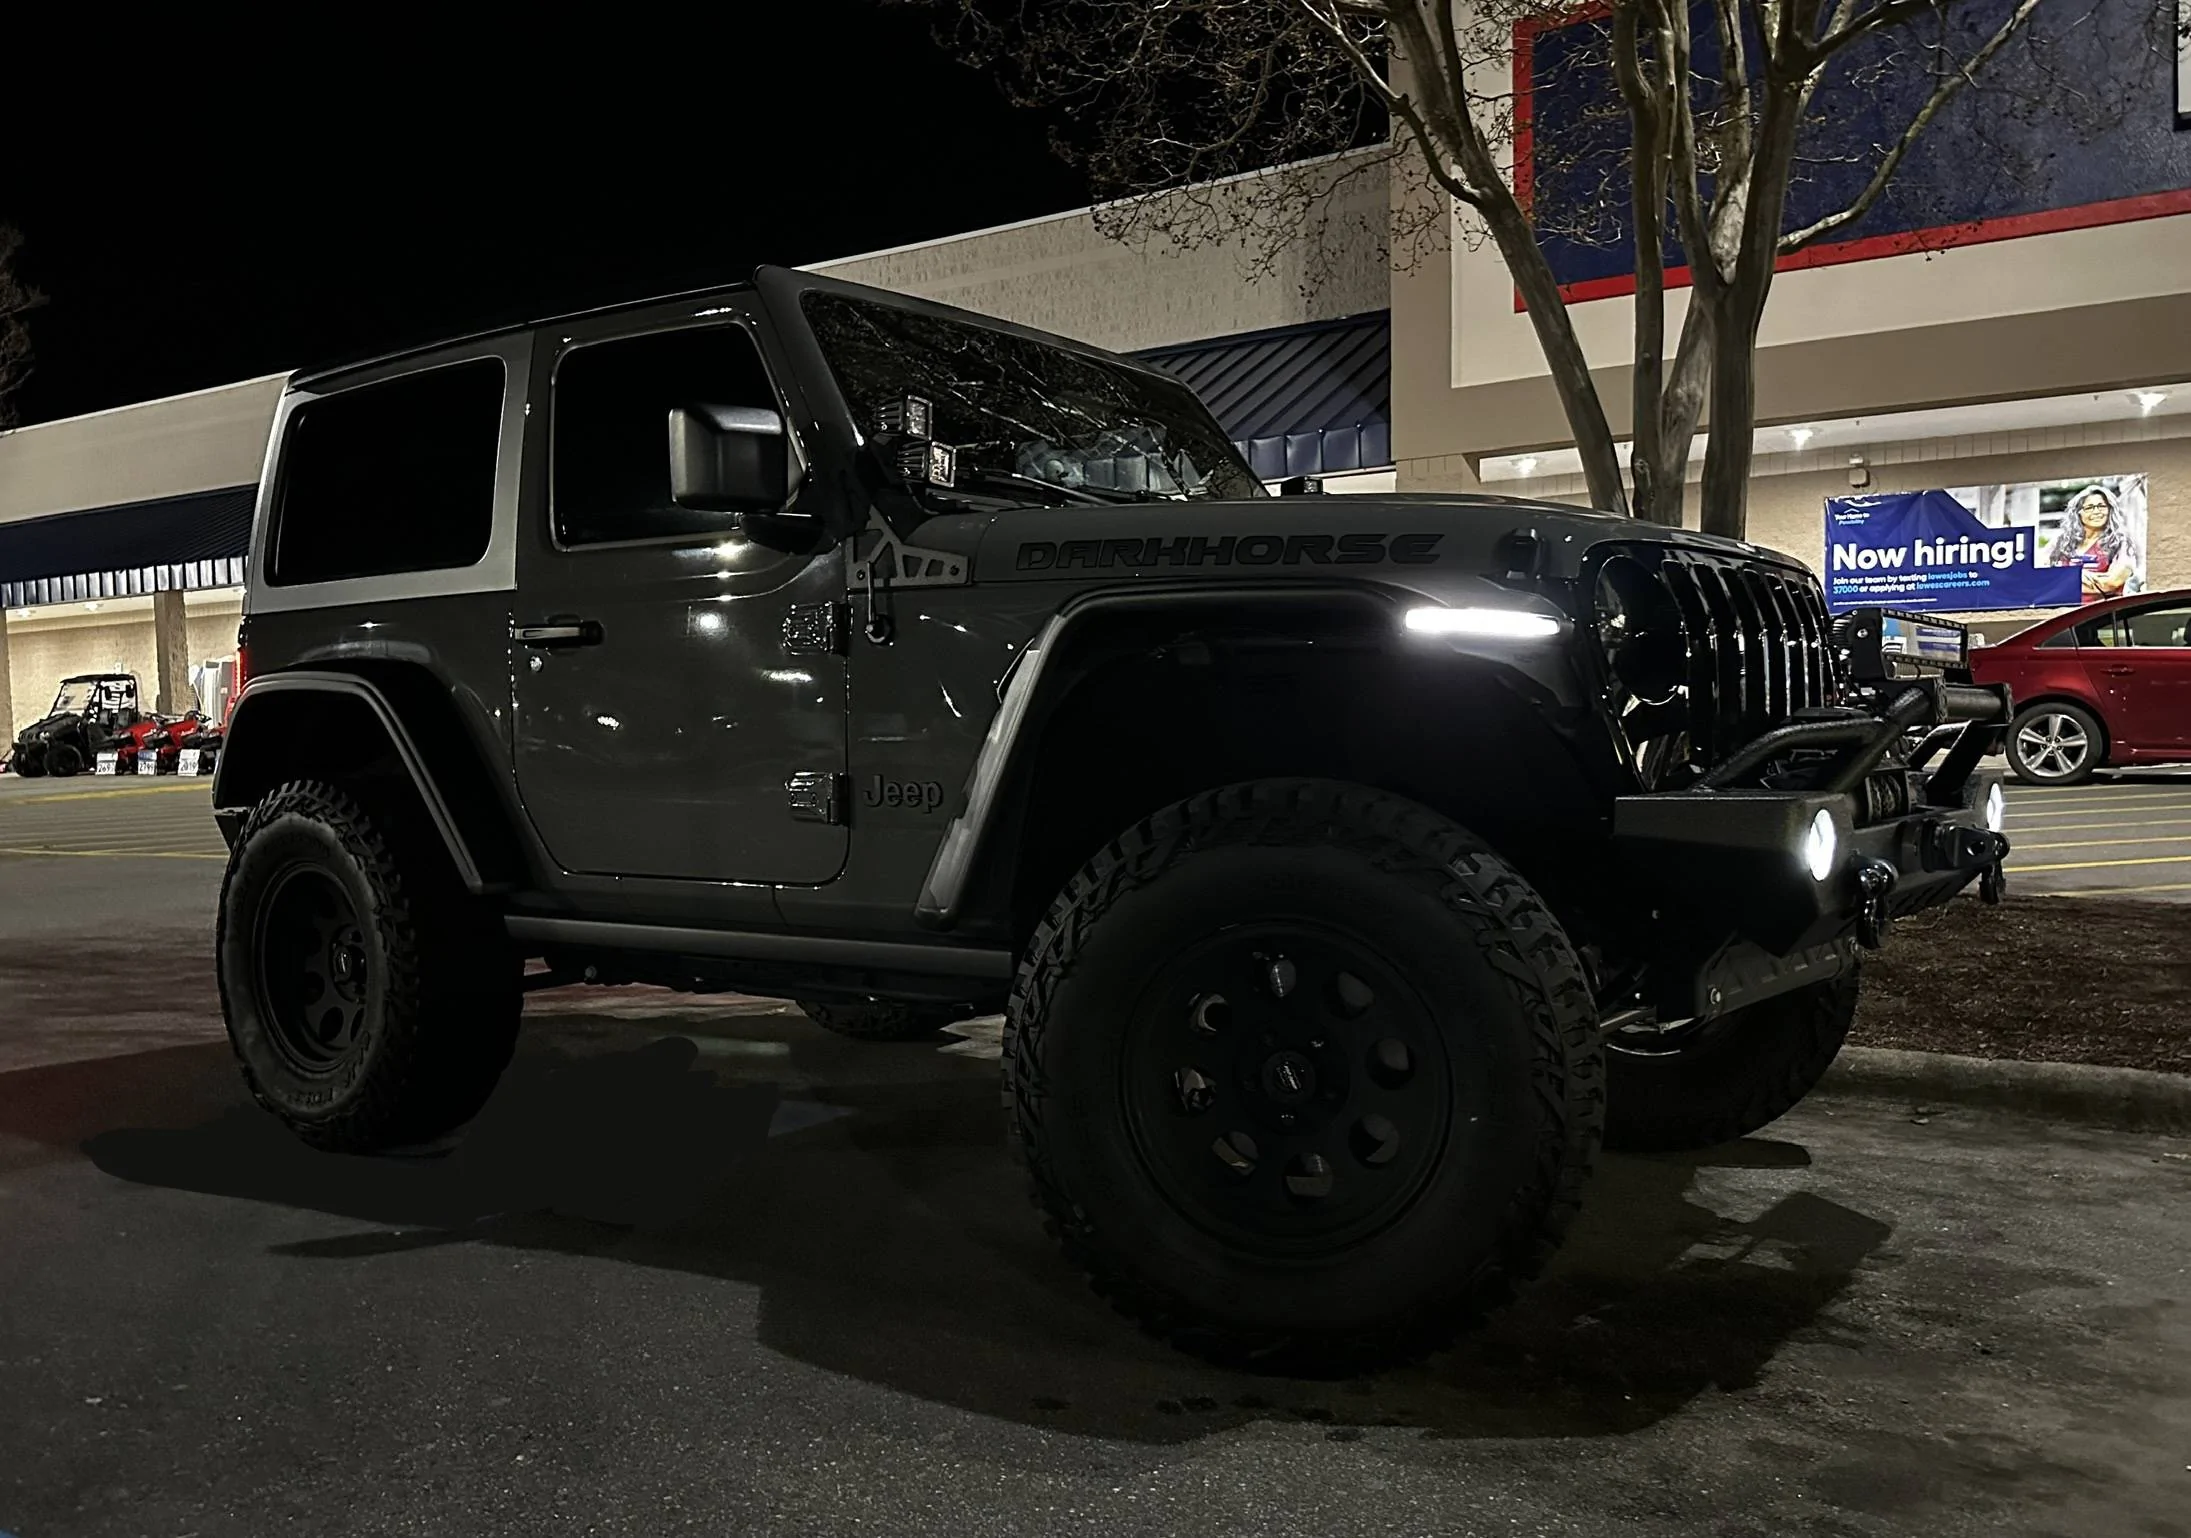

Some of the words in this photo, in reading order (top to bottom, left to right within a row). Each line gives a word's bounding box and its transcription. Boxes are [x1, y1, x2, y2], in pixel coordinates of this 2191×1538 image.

[1015, 533, 1445, 571] DARKHORSE
[1833, 544, 1907, 570] Now
[1914, 533, 2025, 569] hiring!
[1833, 576, 1849, 586] Join
[1849, 577, 1865, 585] our
[1864, 576, 1887, 585] team
[1886, 574, 1898, 585] by
[1899, 572, 1927, 584] texting
[1927, 570, 1968, 582] lowesjobs
[1833, 585, 1858, 594] 37000
[1859, 585, 1868, 593] or
[1870, 583, 1904, 594] applying
[1905, 582, 1916, 591] at
[1916, 579, 1990, 590] lowescareers.com
[863, 774, 943, 814] Jeep
